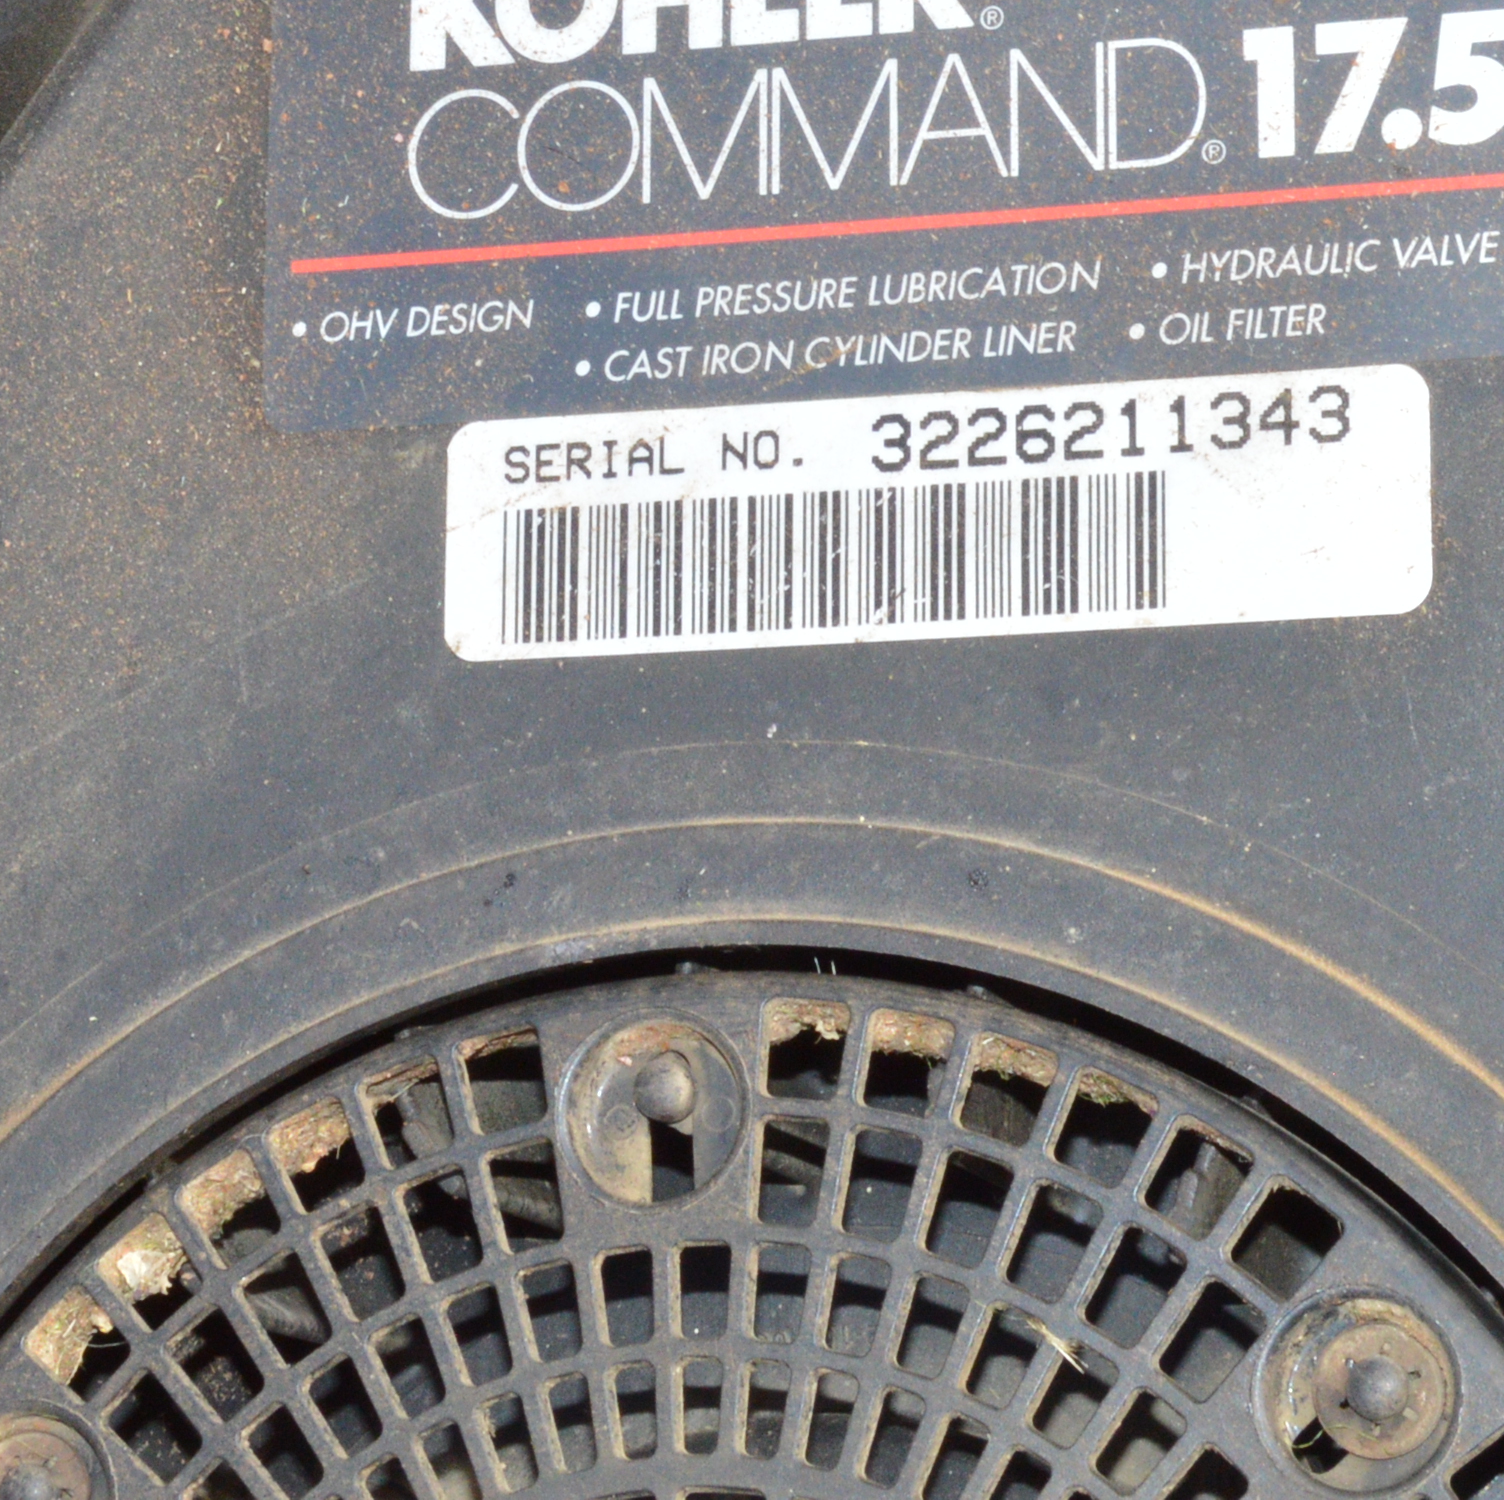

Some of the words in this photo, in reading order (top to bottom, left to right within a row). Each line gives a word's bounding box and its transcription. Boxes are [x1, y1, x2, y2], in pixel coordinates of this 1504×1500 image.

[407, 37, 1207, 219] COMMAND
[1181, 239, 1381, 284] HYDRAULIC
[1392, 231, 1500, 269] VALVE
[319, 308, 408, 343] OHV
[405, 300, 535, 339] DESIGN
[614, 290, 684, 324] FULL
[695, 276, 858, 318] PRESSURE
[867, 260, 1102, 306] LUBRICATION
[603, 345, 693, 382] CAST
[702, 339, 795, 376] IRON
[803, 326, 973, 369] CYLINDER
[983, 321, 1078, 358] LINER
[1158, 311, 1211, 346] OIL
[1225, 303, 1327, 340] FILTER
[503, 437, 686, 485] SERIAL
[722, 428, 805, 472] NO.
[870, 384, 1353, 474] 3226211343
